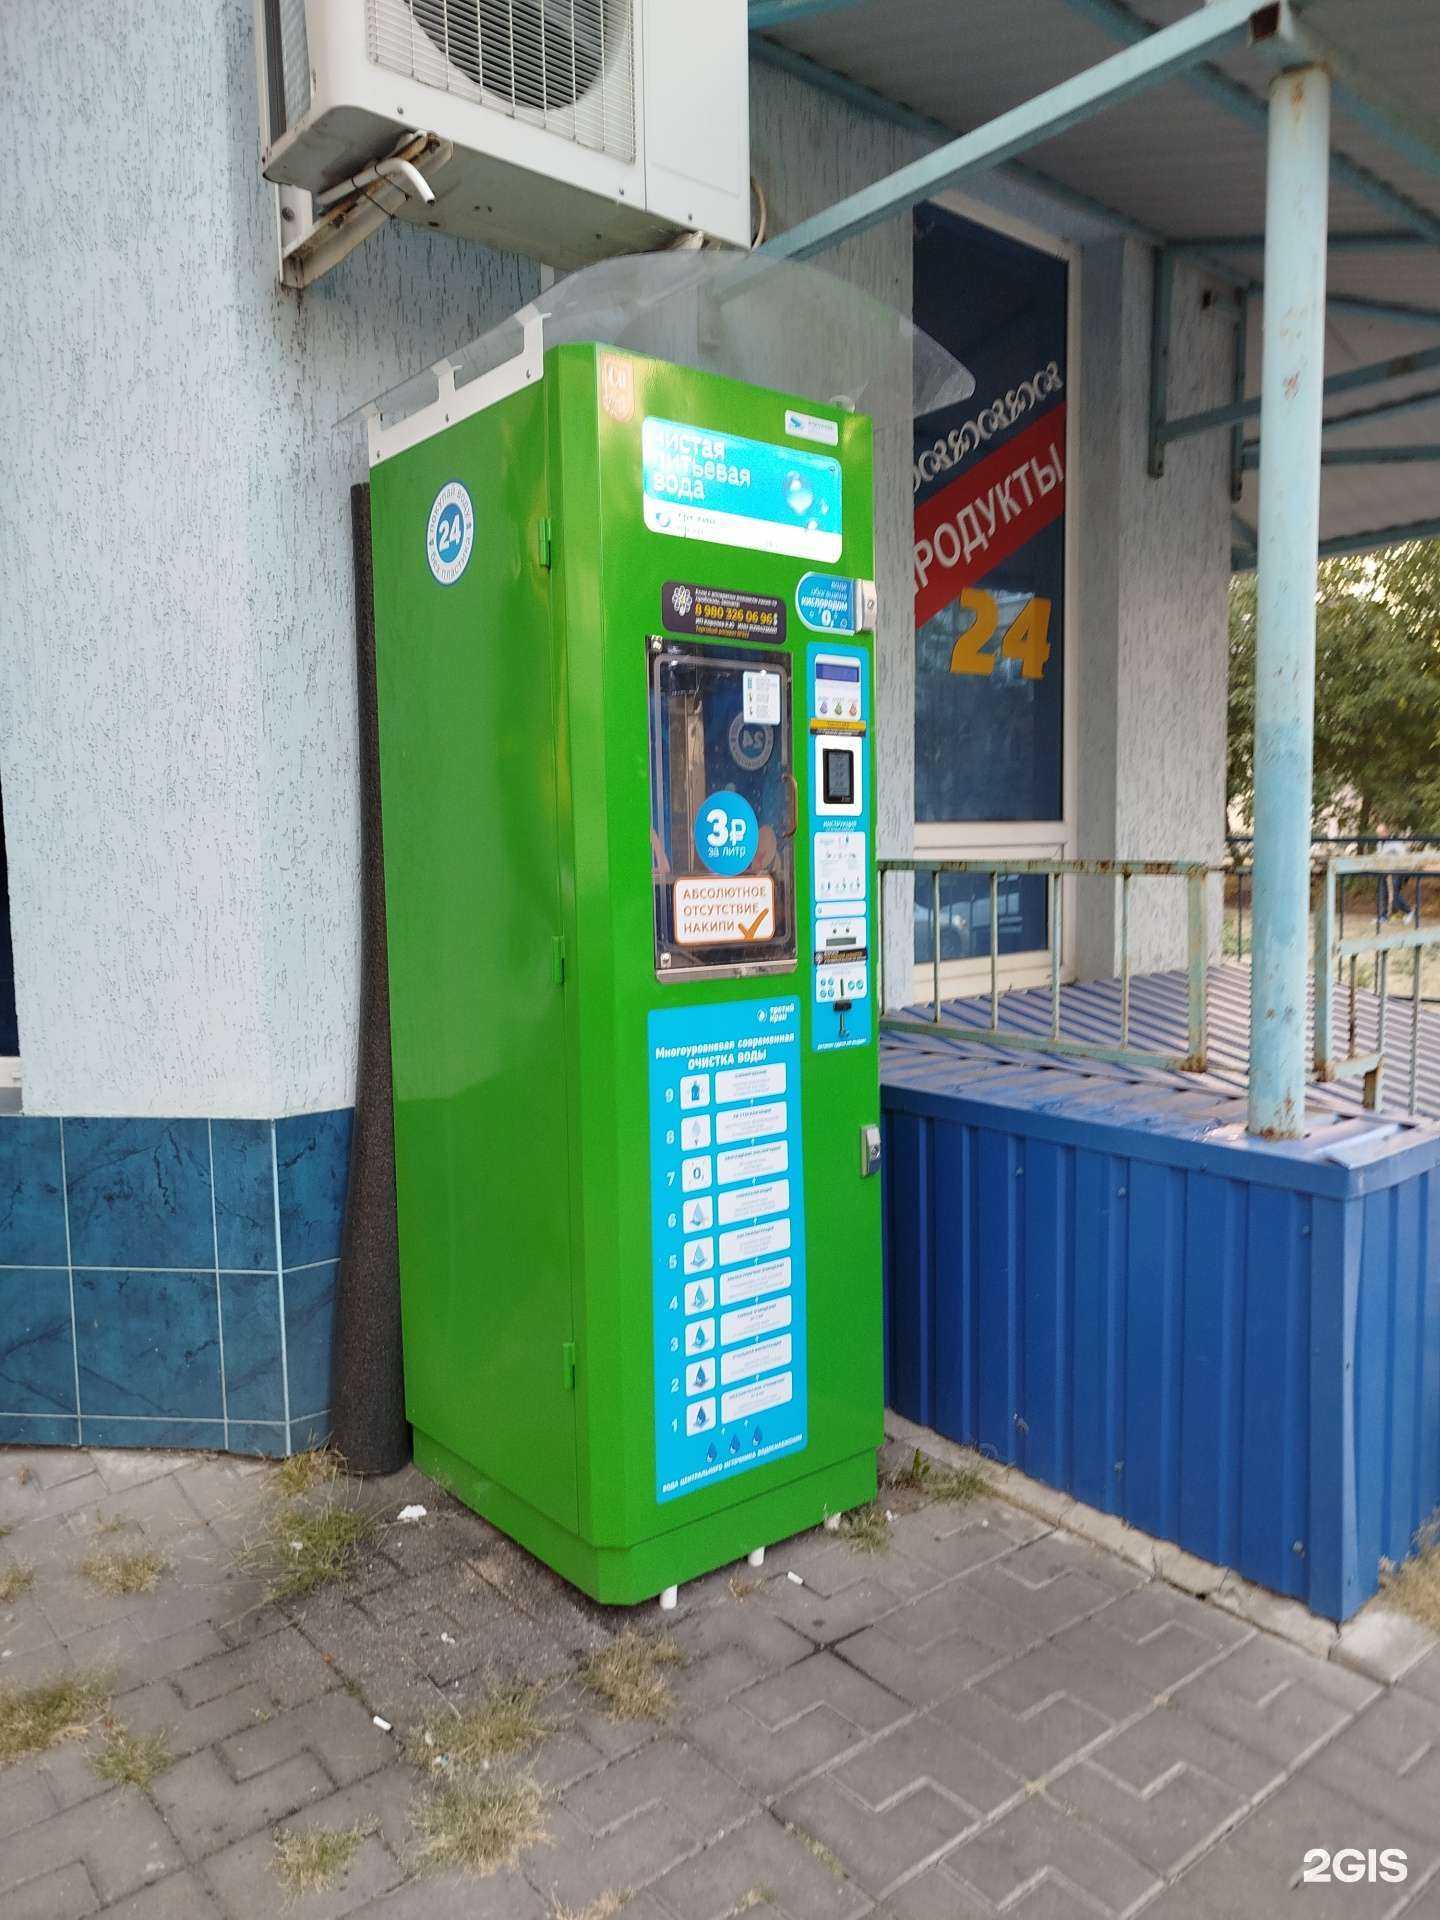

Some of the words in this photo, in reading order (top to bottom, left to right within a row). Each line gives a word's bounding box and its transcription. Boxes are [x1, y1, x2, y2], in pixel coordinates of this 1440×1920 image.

[655, 432, 725, 462] истая
[653, 473, 704, 500] вода
[913, 442, 1064, 596] РОДУКТЫ
[439, 513, 462, 553] 24
[950, 588, 1052, 680] 24
[708, 847, 720, 858] за
[722, 847, 747, 859] литр
[683, 886, 767, 900] АБСОЛЮТНОЕ
[683, 902, 759, 917] ОТСУТСТВИЕ
[683, 919, 735, 934] НАКИПИ
[665, 1088, 674, 1103] 9
[666, 1130, 675, 1144] 8
[666, 1171, 675, 1186] 7
[669, 1296, 678, 1310] 4
[670, 1337, 679, 1352] 3
[671, 1378, 679, 1392] 2
[672, 1419, 678, 1432] 1
